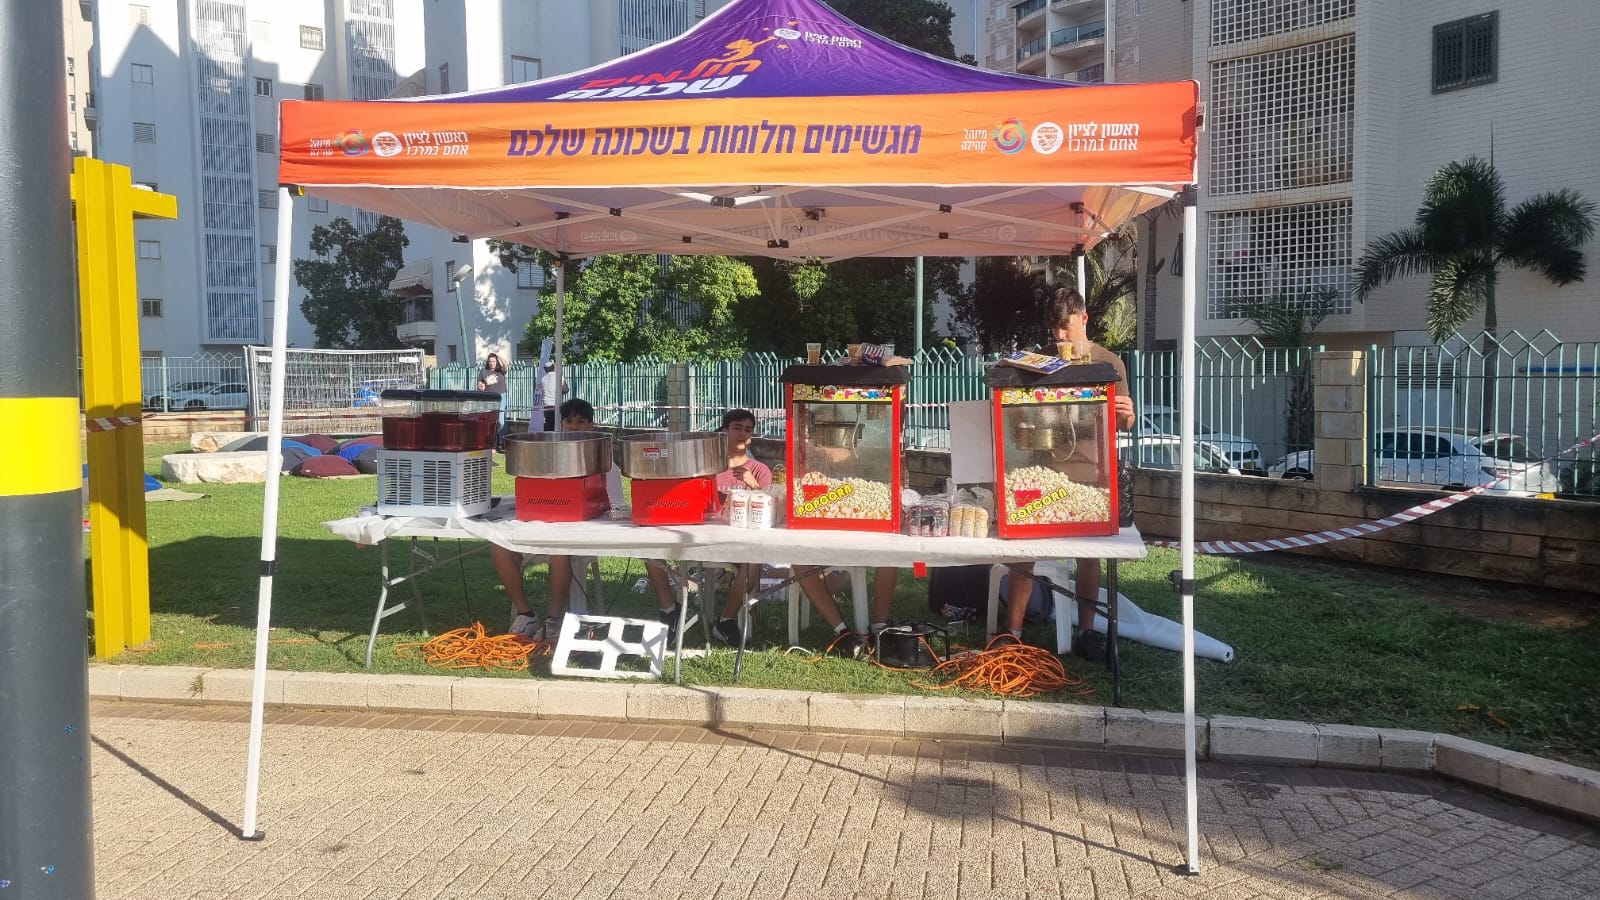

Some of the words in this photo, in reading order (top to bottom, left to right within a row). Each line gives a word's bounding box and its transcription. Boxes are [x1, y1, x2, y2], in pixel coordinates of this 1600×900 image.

[546, 74, 749, 99] שכונה
[402, 130, 430, 146] לציון
[697, 119, 797, 155] חלומות
[1068, 121, 1098, 138] לציון
[1101, 122, 1140, 138] ראשון
[432, 131, 469, 146] ראשון
[507, 123, 586, 156] שלכם
[592, 125, 691, 155] בשכונה
[803, 124, 922, 155] מגשימים
[1068, 138, 1104, 152] במרכז
[1109, 138, 1138, 151] אתם
[406, 144, 439, 156] במרכז
[443, 144, 469, 156] אתם
[796, 484, 853, 516] POPCORN
[1009, 487, 1068, 523] POPCORN
